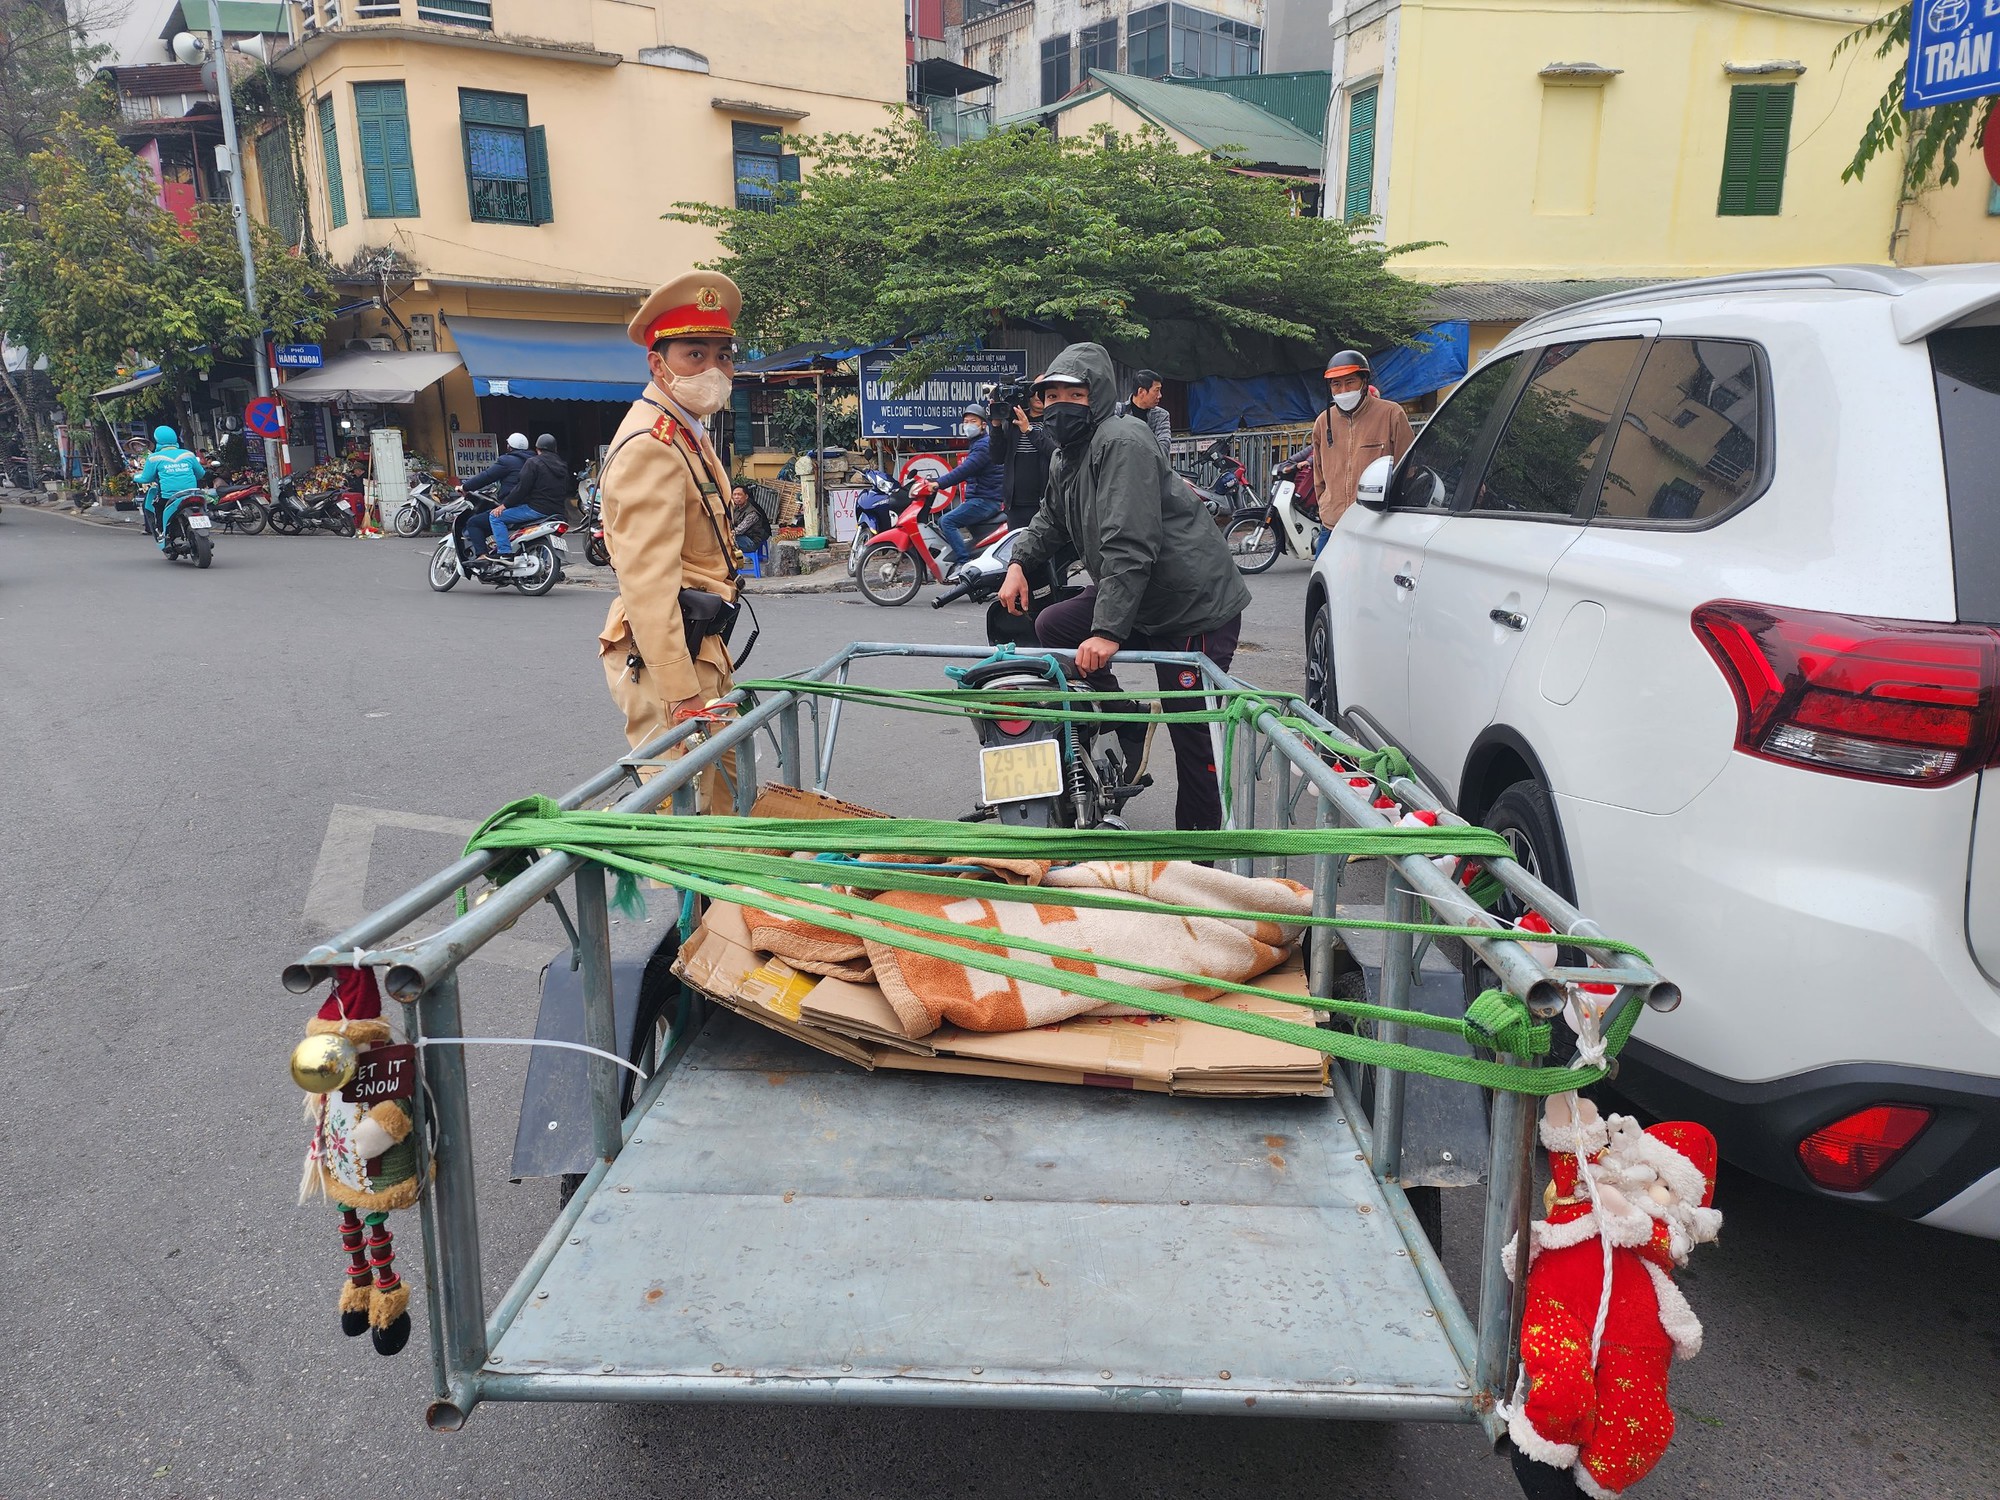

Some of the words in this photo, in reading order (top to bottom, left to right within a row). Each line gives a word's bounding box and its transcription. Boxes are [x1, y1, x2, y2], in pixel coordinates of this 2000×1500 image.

[1925, 22, 1993, 85] TRẦN
[278, 353, 298, 363] HÀNG
[299, 355, 319, 364] KHOAI
[995, 354, 1006, 362] NAM
[990, 362, 1000, 372] SẮT
[866, 380, 878, 401] GA
[928, 378, 949, 401] KÍNH
[950, 379, 973, 402] CHÀO
[881, 405, 913, 417] WELCOME
[914, 406, 923, 417] TO
[923, 406, 941, 417] LONG
[942, 406, 957, 417] BIEN
[458, 438, 475, 448] SIM
[476, 435, 492, 448] THẺ
[388, 1059, 407, 1075] IT
[355, 1077, 400, 1098] SNOW
